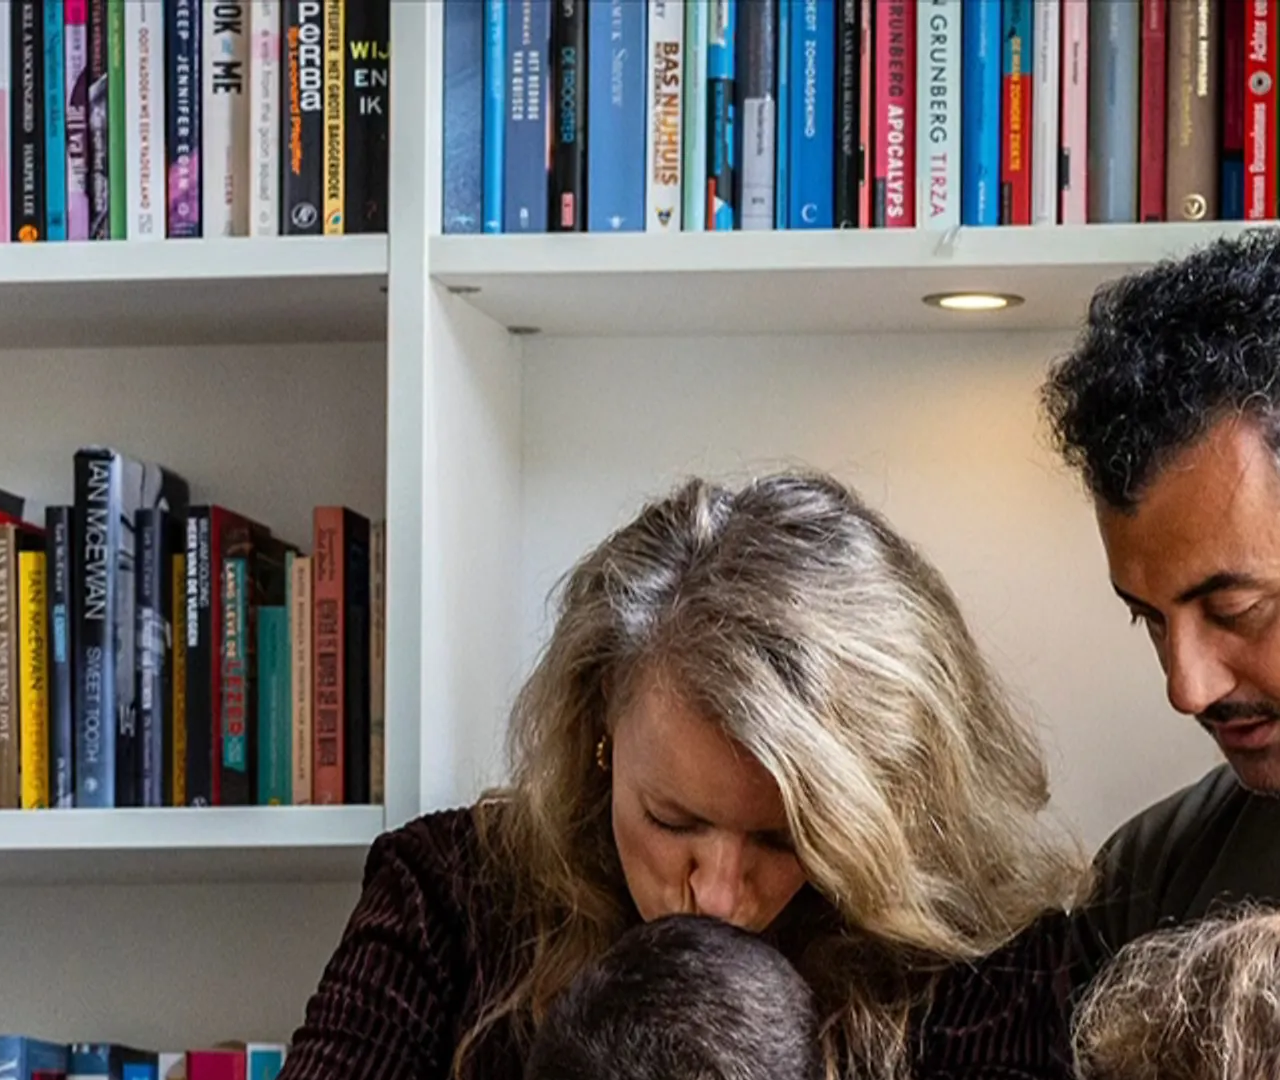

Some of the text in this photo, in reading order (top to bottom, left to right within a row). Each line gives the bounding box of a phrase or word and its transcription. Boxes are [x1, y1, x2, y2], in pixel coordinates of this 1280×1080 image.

[213, 61, 242, 94] ME
[350, 41, 391, 60] WIJ
[354, 68, 387, 87] EN
[359, 95, 382, 115] IK
[328, 60, 340, 200] HET GROTE BAGGERBOEK
[661, 41, 679, 186] BAS NIJHUIS
[887, 104, 904, 217] APOCALYPS
[930, 15, 947, 218] GRUNBERG TIRZA
[85, 461, 110, 762] IAN McEWAN SWEET TOOTH
[187, 518, 198, 646] HEER VAN DE VLIEGEN
